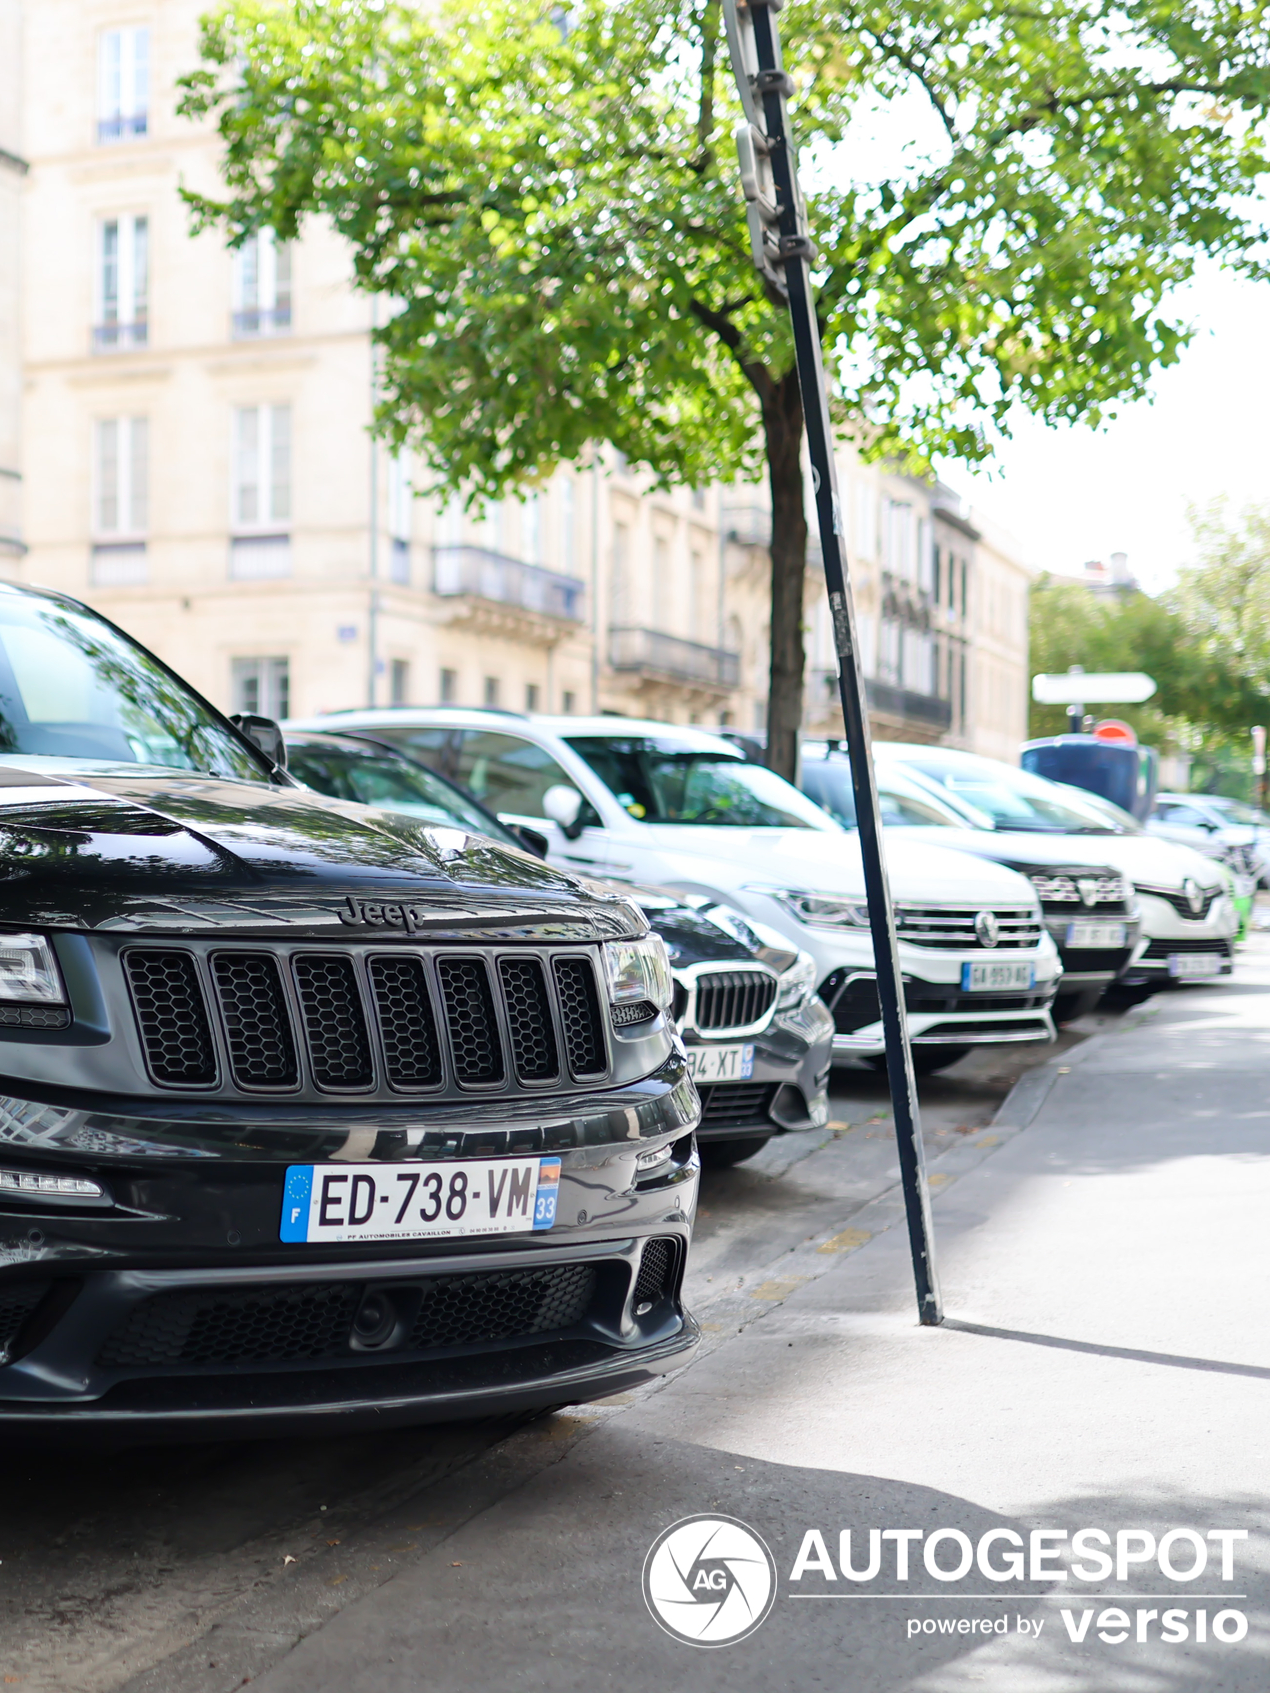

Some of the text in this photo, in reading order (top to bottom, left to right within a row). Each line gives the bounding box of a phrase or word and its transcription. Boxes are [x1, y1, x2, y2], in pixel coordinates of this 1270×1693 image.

[337, 896, 424, 934] Jeep
[319, 1167, 532, 1226] ED-738-VM
[291, 1208, 301, 1224] F
[536, 1197, 555, 1219] 33
[358, 1232, 411, 1240] AUTOMOBILES
[412, 1229, 451, 1237] CAVAILLON
